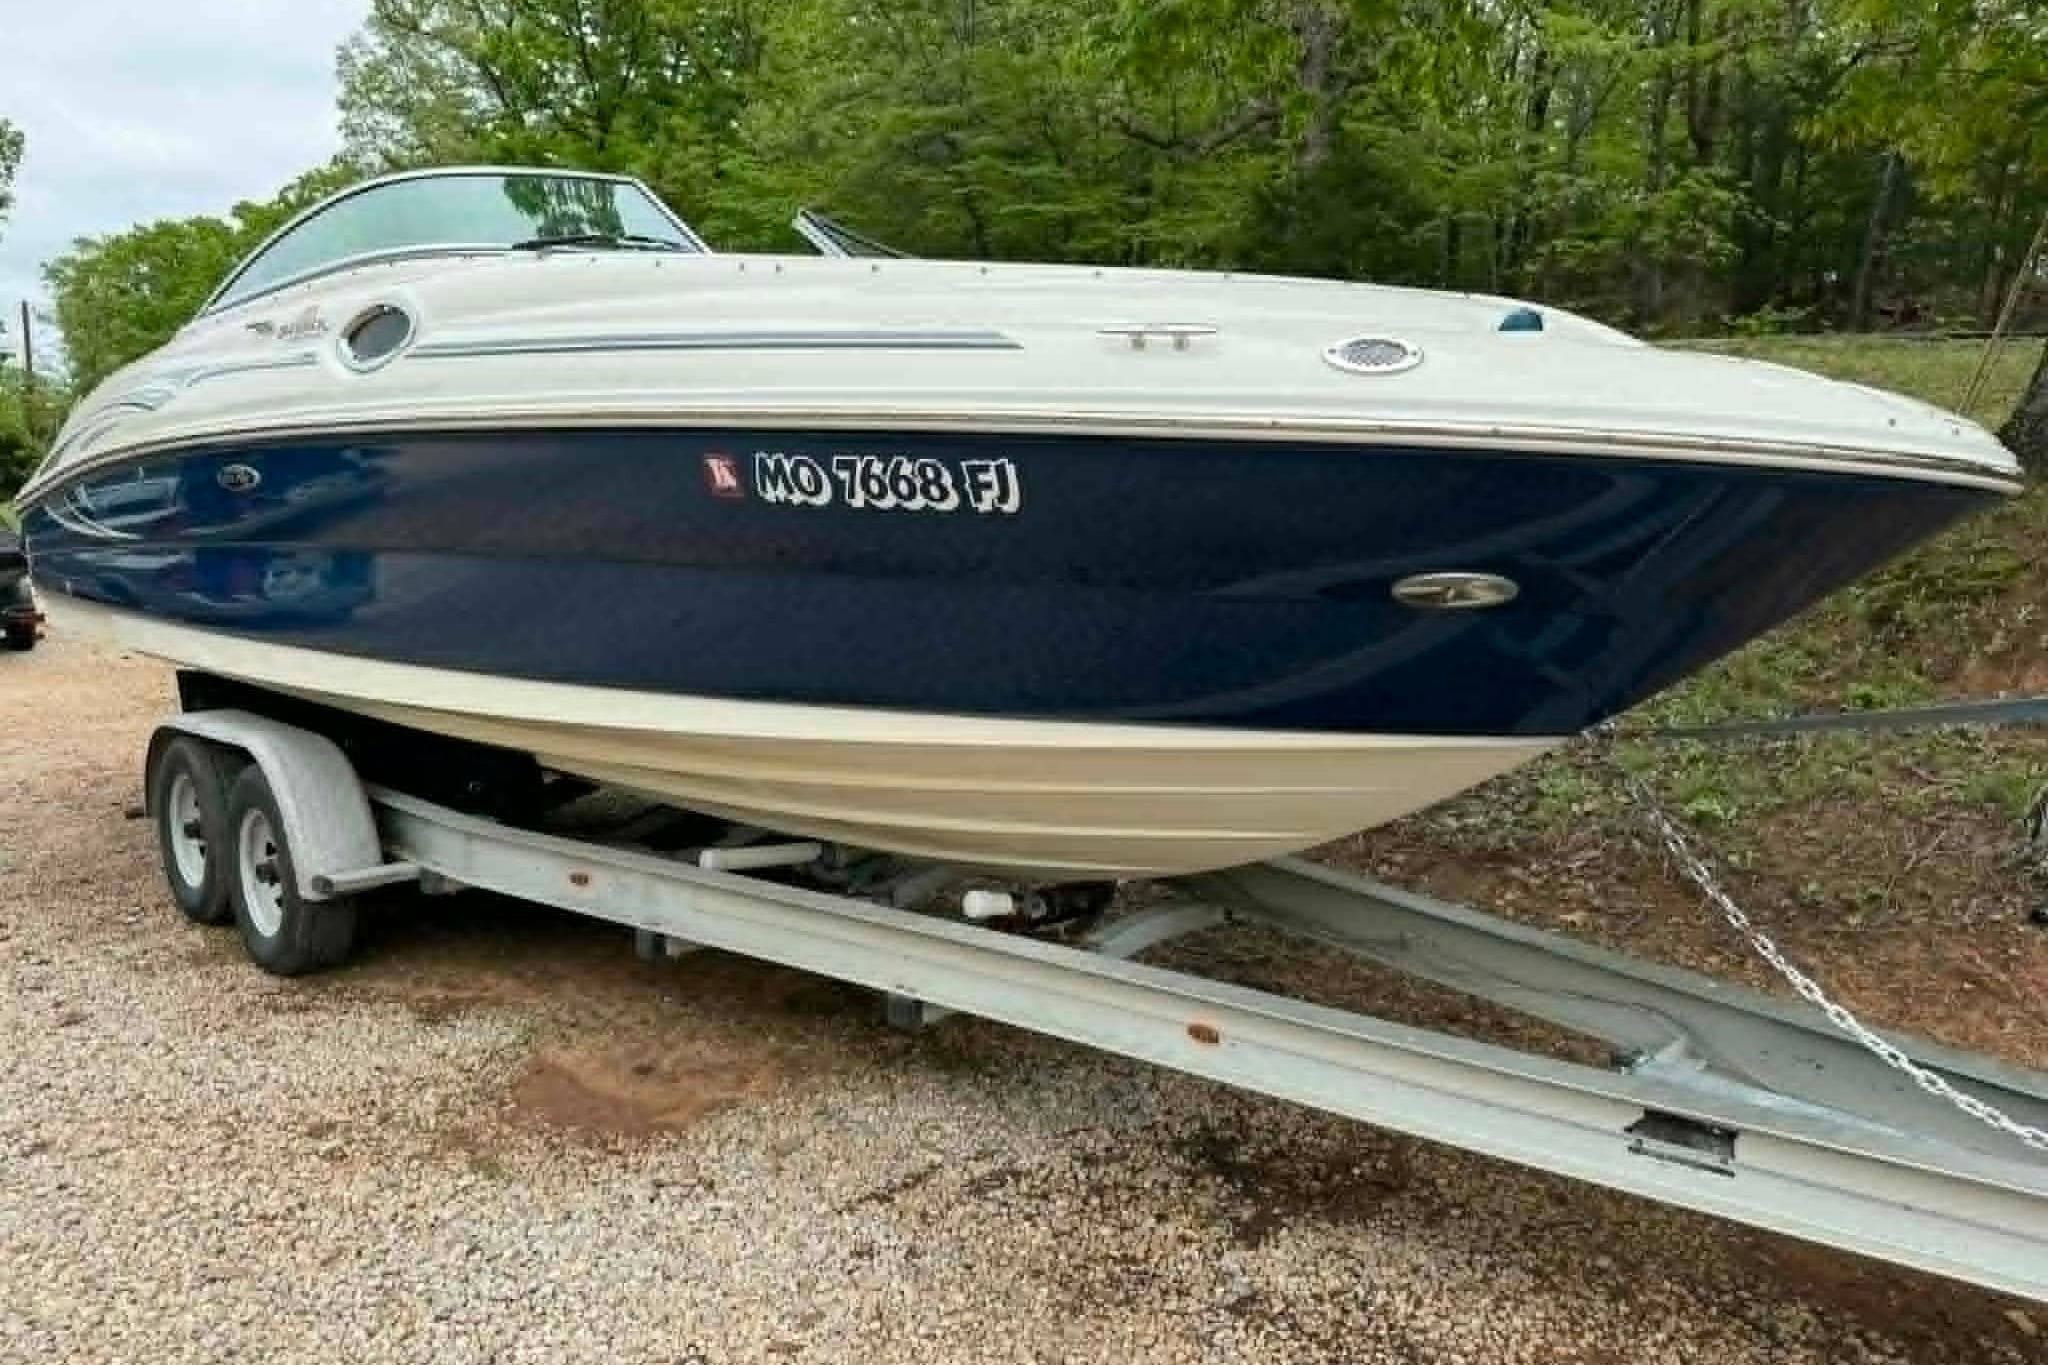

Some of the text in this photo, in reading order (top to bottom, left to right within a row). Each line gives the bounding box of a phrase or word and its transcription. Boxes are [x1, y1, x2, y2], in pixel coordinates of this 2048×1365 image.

[753, 452, 832, 506] MO
[834, 456, 958, 511] 7668
[961, 458, 1020, 513] FJ
